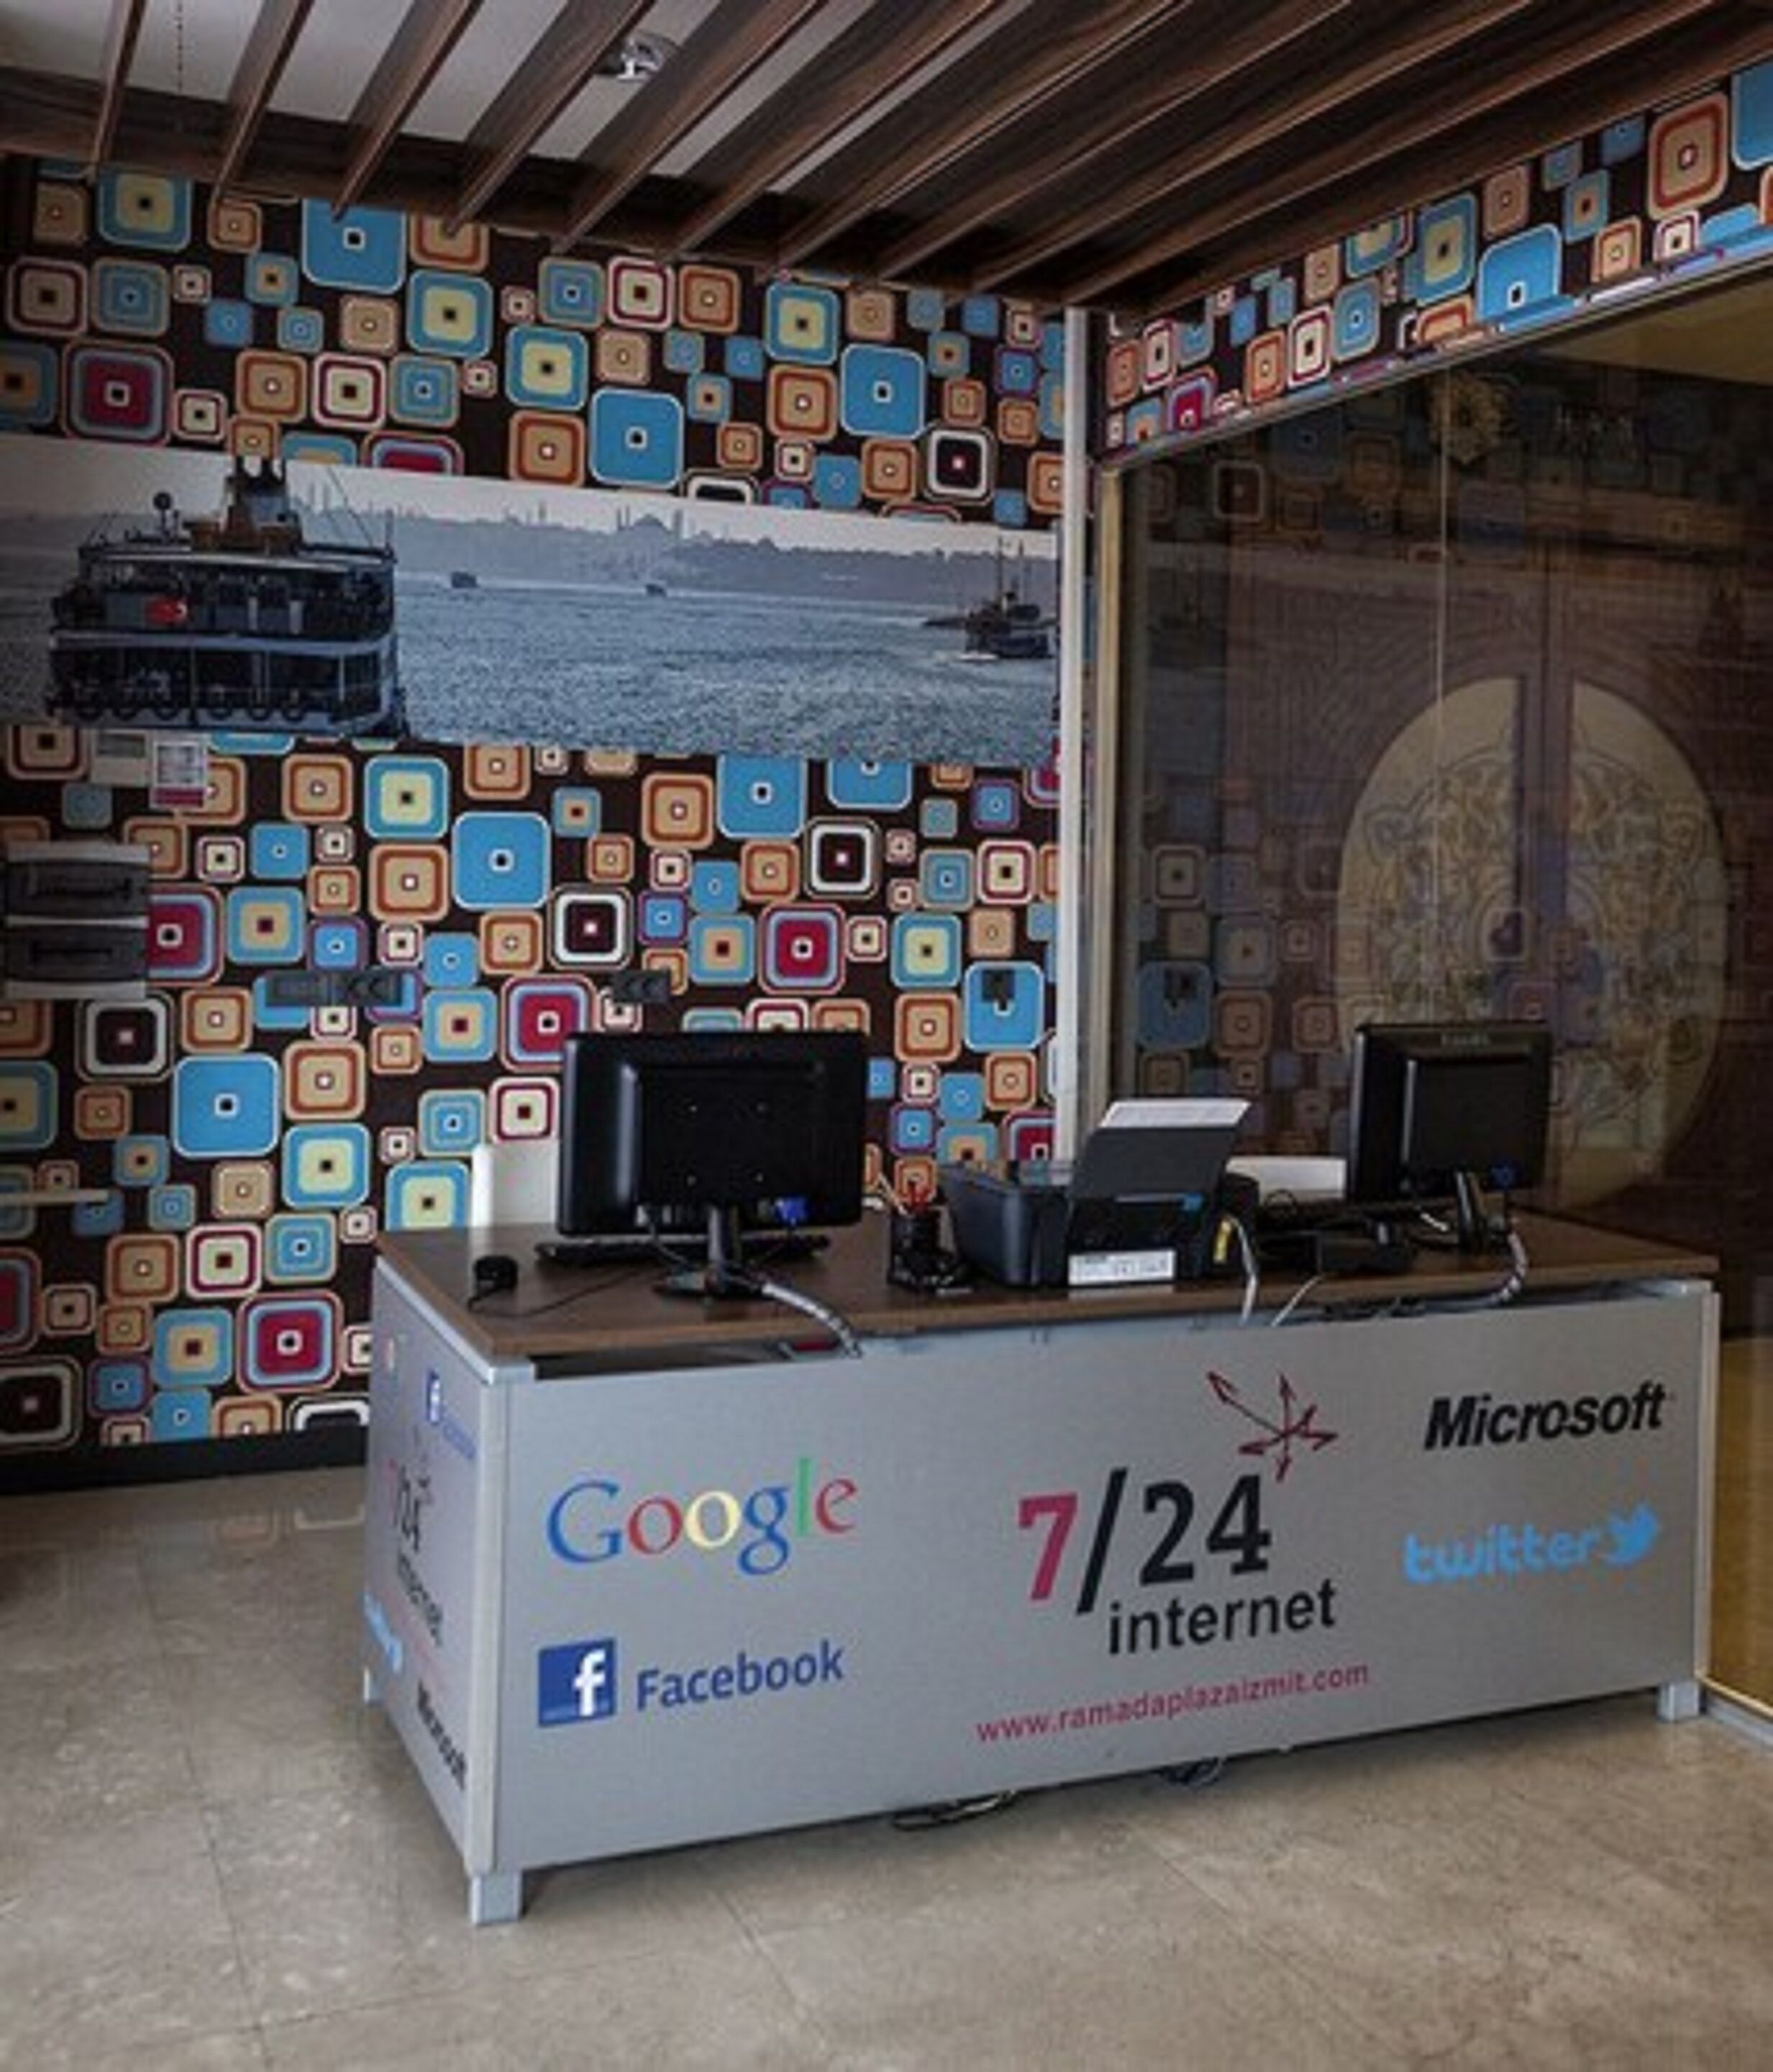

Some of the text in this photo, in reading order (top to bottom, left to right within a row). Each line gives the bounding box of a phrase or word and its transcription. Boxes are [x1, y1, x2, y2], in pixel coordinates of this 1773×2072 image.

[1424, 1380, 1666, 1451] Microsoft
[547, 1458, 857, 1576] Google
[1017, 1468, 1272, 1616] 7/24
[1403, 1522, 1601, 1584] twitter
[1108, 1578, 1336, 1655] internet
[637, 1640, 844, 1710] Facebook
[976, 1664, 1369, 1742] www.ramadaplazaizmit.com
